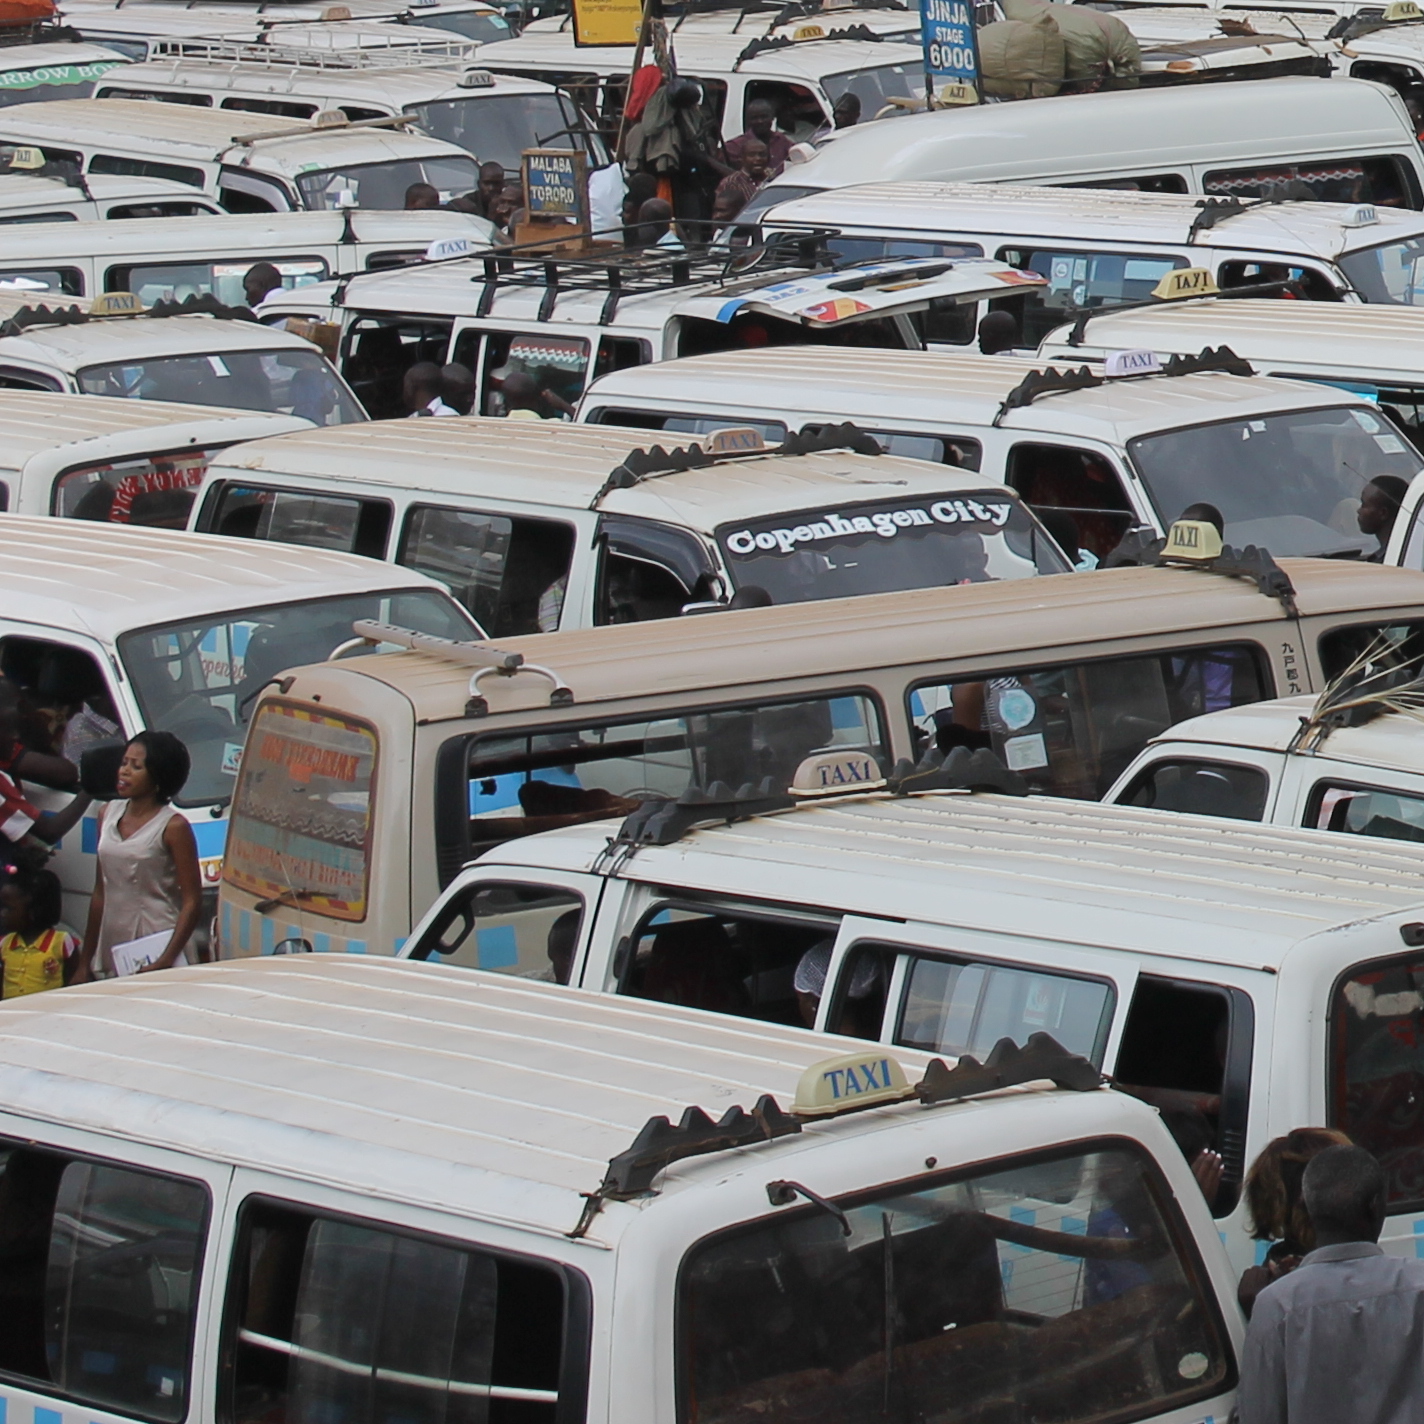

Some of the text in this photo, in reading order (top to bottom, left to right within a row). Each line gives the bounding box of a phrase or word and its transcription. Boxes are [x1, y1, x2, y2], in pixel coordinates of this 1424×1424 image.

[926, 0, 969, 26] JINJA
[802, 27, 822, 37] TAXI
[935, 26, 965, 44] STAGE
[469, 75, 490, 84] TAXI
[530, 156, 572, 174] MALABA
[543, 173, 561, 185] VIA
[531, 186, 574, 203] TORORO
[1359, 208, 1376, 222] TAXI
[441, 240, 468, 254] TAXI
[1174, 271, 1208, 290] TAXI
[106, 296, 135, 309] TAXI
[1120, 353, 1152, 369] TAXI
[720, 433, 758, 450] TAXI
[726, 498, 1013, 556] Copenhagen City
[1173, 524, 1198, 548] TAXI
[817, 759, 871, 786] TAXI
[824, 1058, 893, 1099] TAXI
